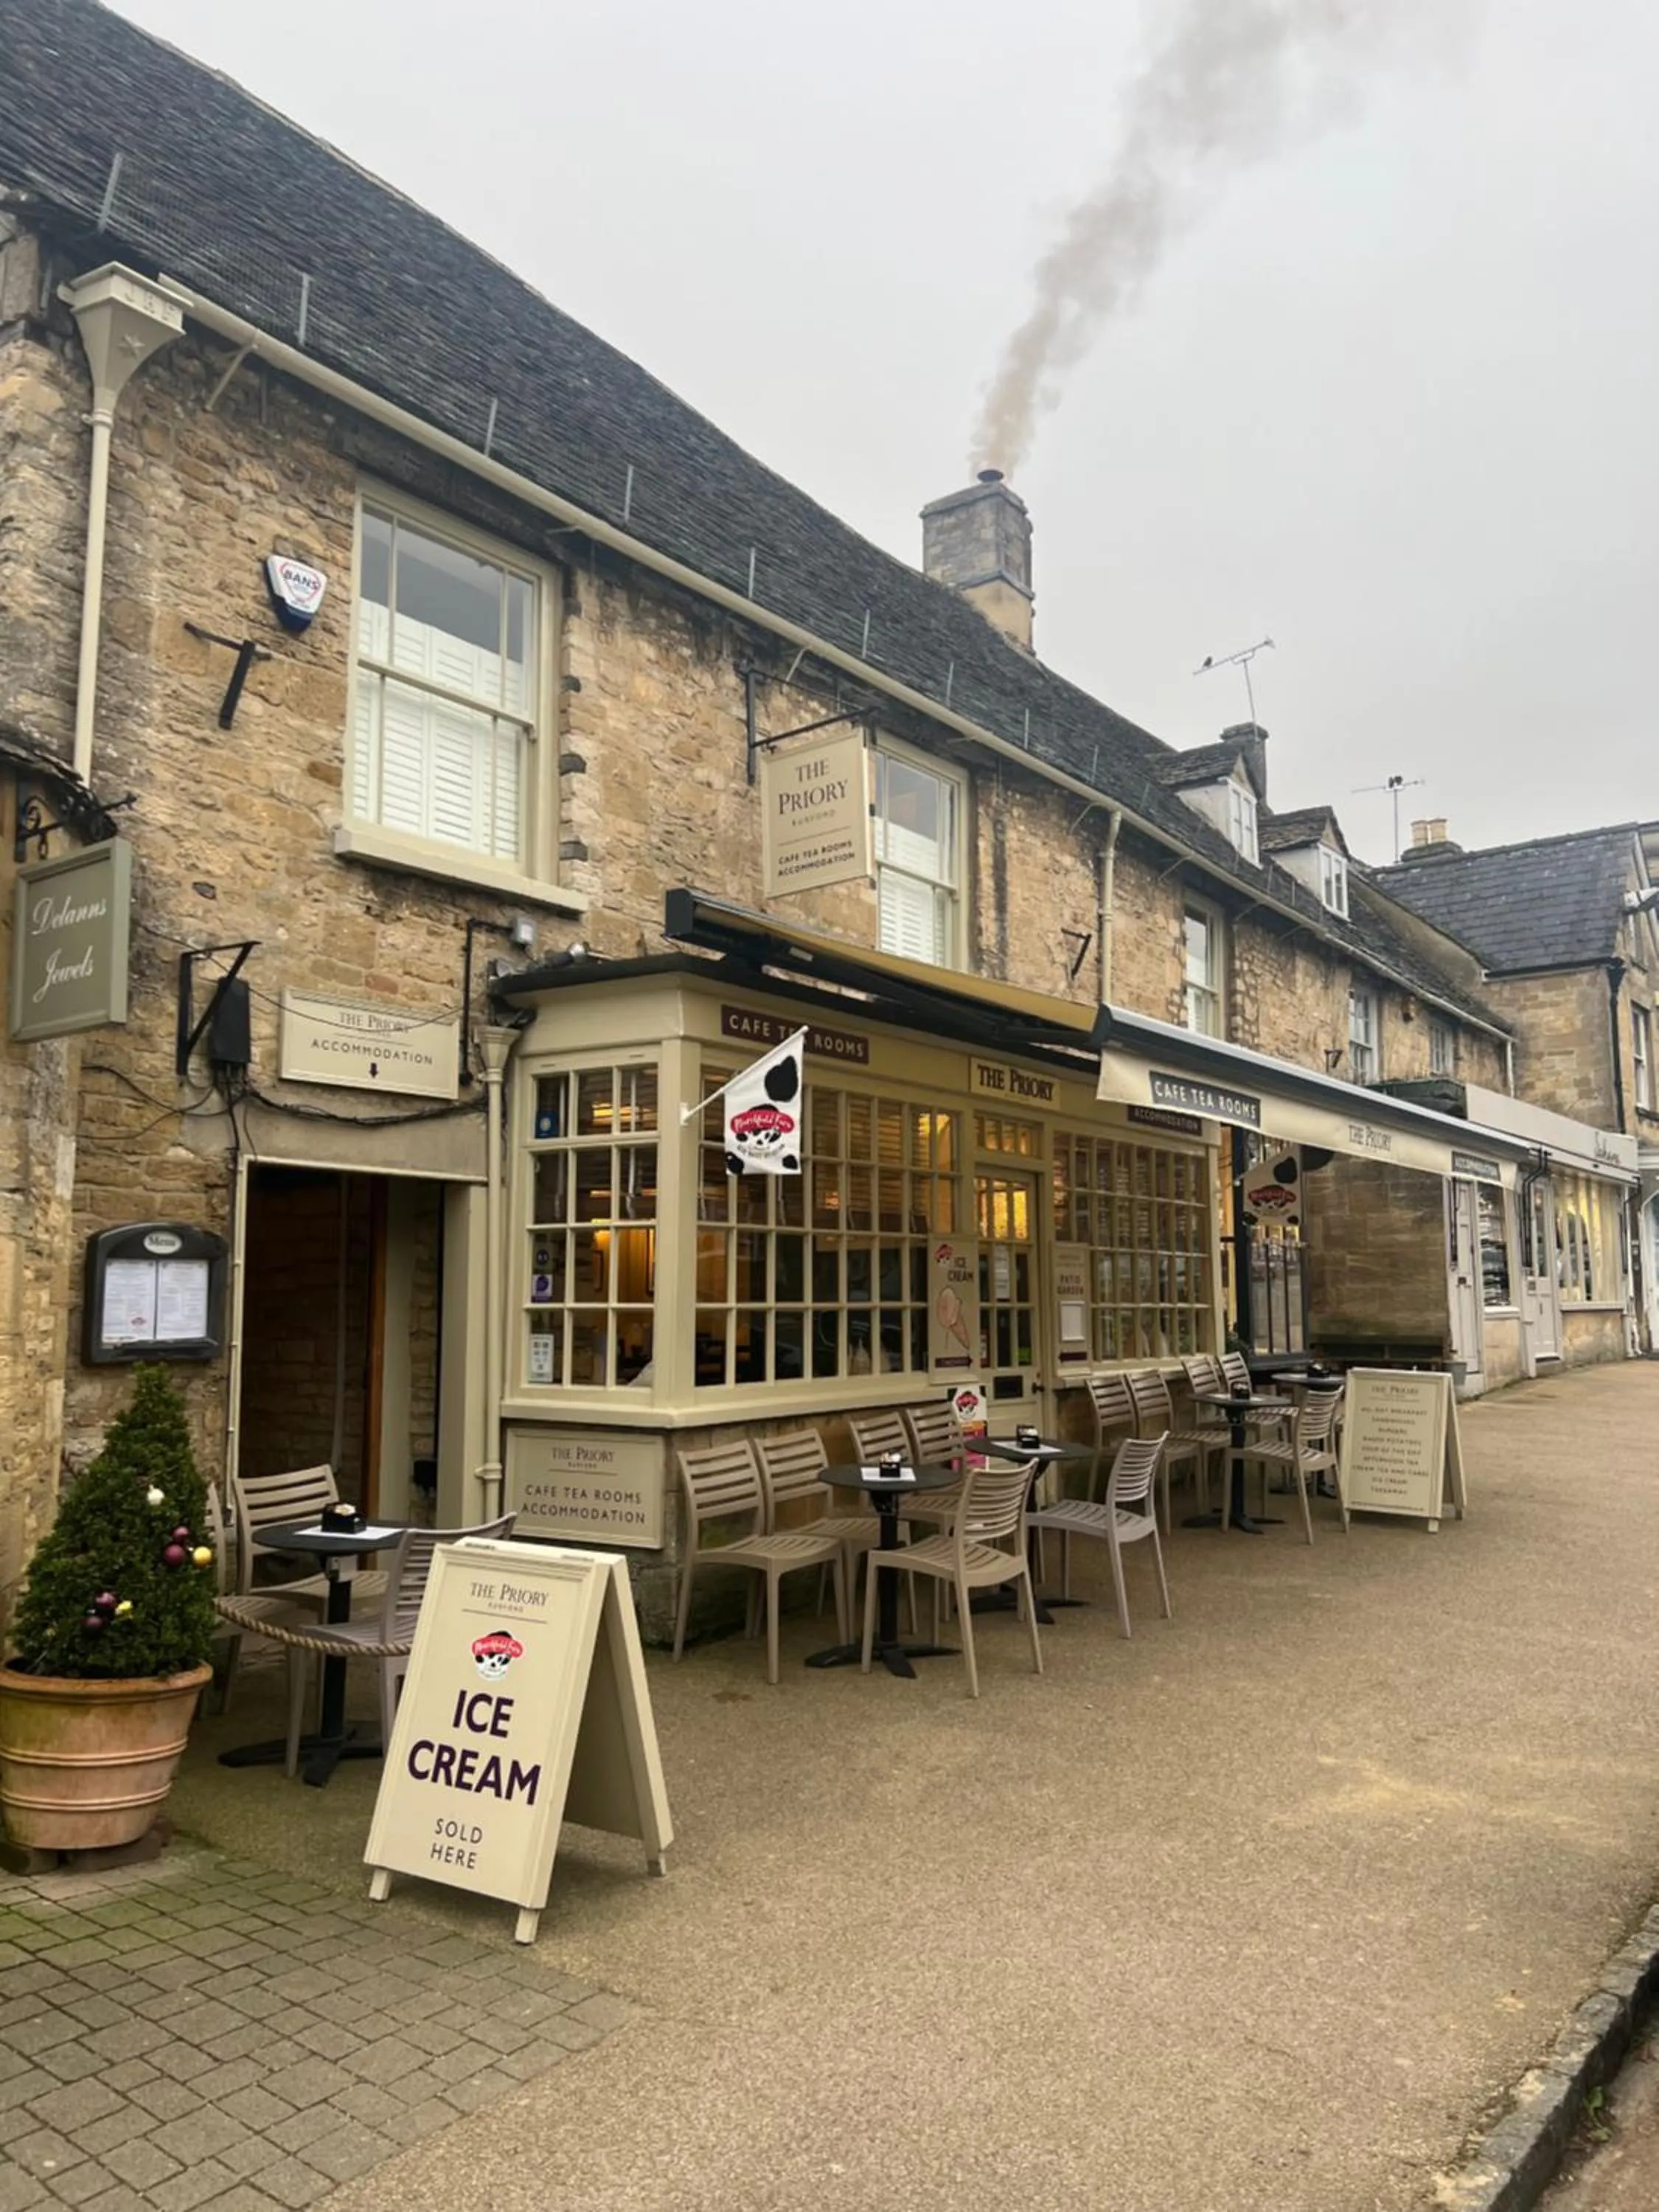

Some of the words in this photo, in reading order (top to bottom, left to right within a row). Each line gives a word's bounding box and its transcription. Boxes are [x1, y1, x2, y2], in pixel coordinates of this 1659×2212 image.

[796, 758, 830, 782] THE
[779, 780, 847, 814] PRIORY
[778, 852, 855, 877] ACCOMMODATION
[779, 854, 799, 865] CAFE
[804, 848, 818, 859] TEA
[821, 841, 852, 854] ROOMS
[32, 945, 94, 1003] Jewels
[340, 1013, 364, 1027] THE
[729, 1015, 770, 1037] CAFE
[815, 1034, 863, 1057] ROOMS
[311, 1038, 433, 1065] ACCOMMODATION
[977, 1063, 1004, 1090] THE
[1010, 1068, 1054, 1101] PRIORY
[1155, 1080, 1186, 1102] CAFE
[1191, 1088, 1214, 1109] TEA
[1219, 1096, 1256, 1119] ROOMS
[1349, 1124, 1364, 1145] THE
[954, 1256, 966, 1268] ICE
[947, 1270, 974, 1281] CREAM
[552, 1447, 571, 1459] THE
[577, 1446, 616, 1463] PRIORY
[525, 1484, 556, 1498] CAFE
[564, 1486, 588, 1499] TEA
[594, 1489, 641, 1505] ROOMS
[521, 1503, 645, 1524] ACCOMMODATION
[471, 1582, 495, 1599] THE
[500, 1583, 549, 1606] PRIORY
[453, 1689, 514, 1738] ICE
[408, 1739, 541, 1806] CREAM
[435, 1818, 483, 1844] SOLD
[431, 1843, 477, 1870] HERE
